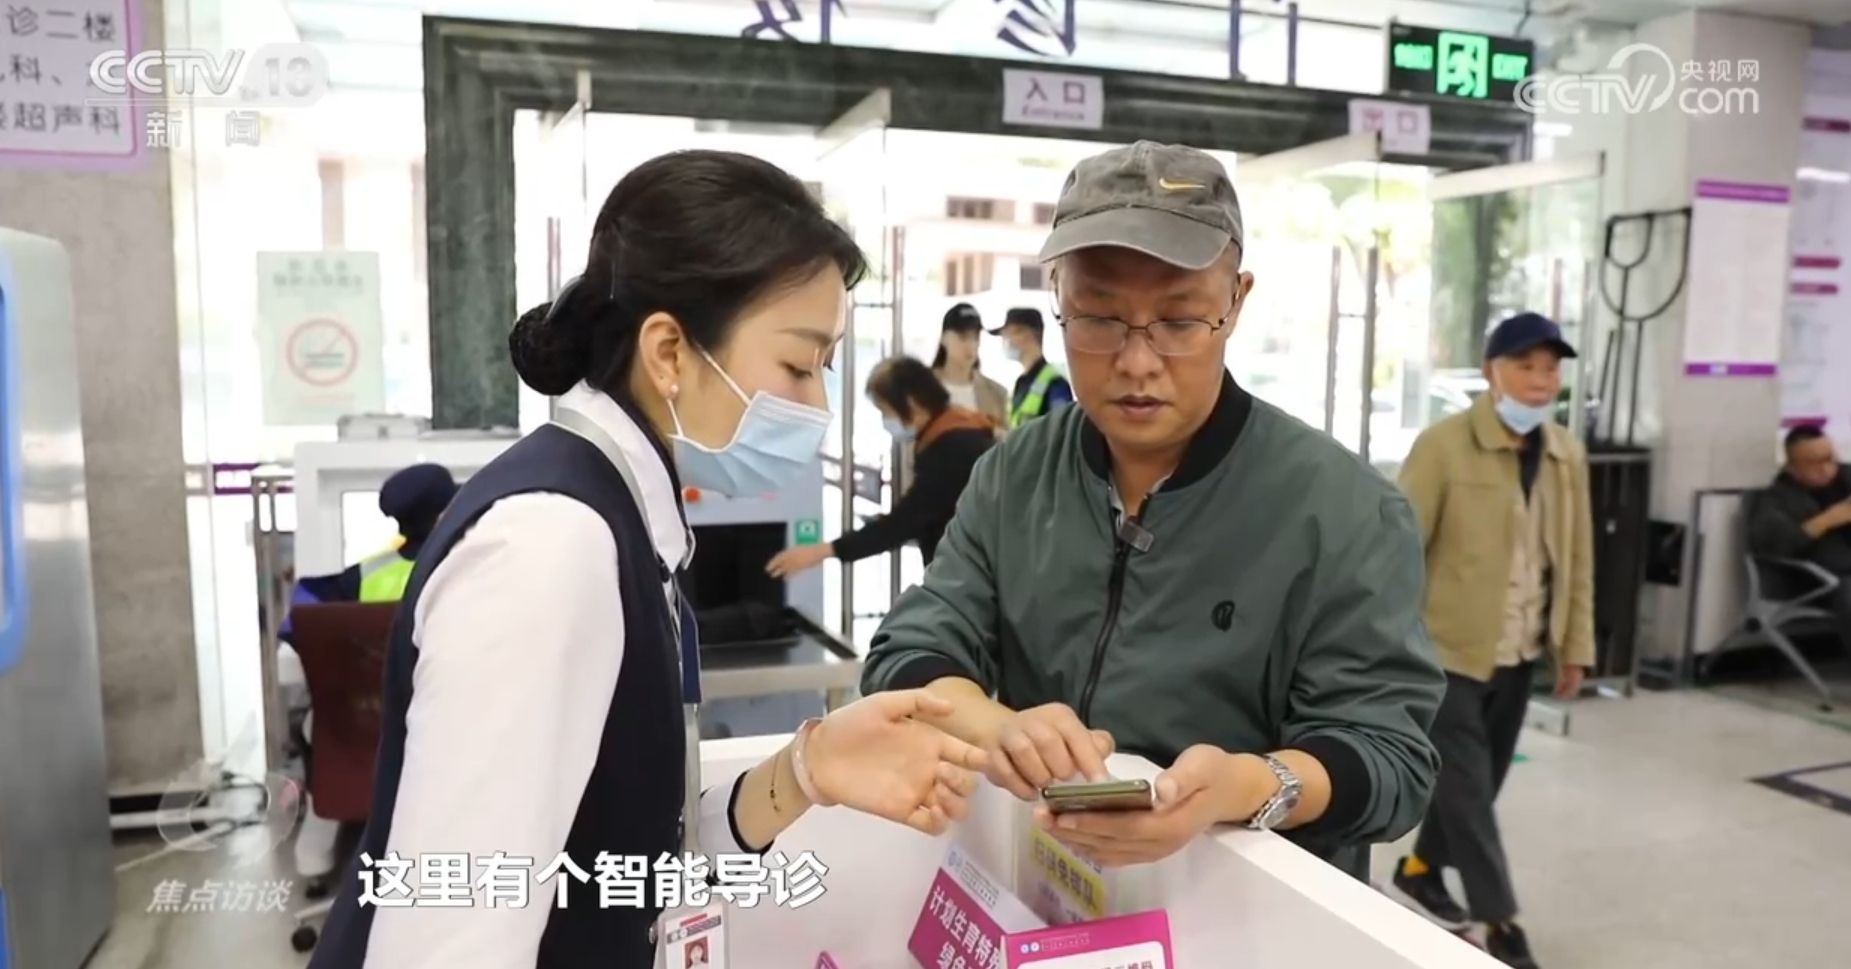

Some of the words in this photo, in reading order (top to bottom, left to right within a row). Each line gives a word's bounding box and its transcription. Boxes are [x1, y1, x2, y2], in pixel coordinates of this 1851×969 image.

[6, 4, 116, 43] 诊二楼
[1025, 77, 1086, 106] 入口
